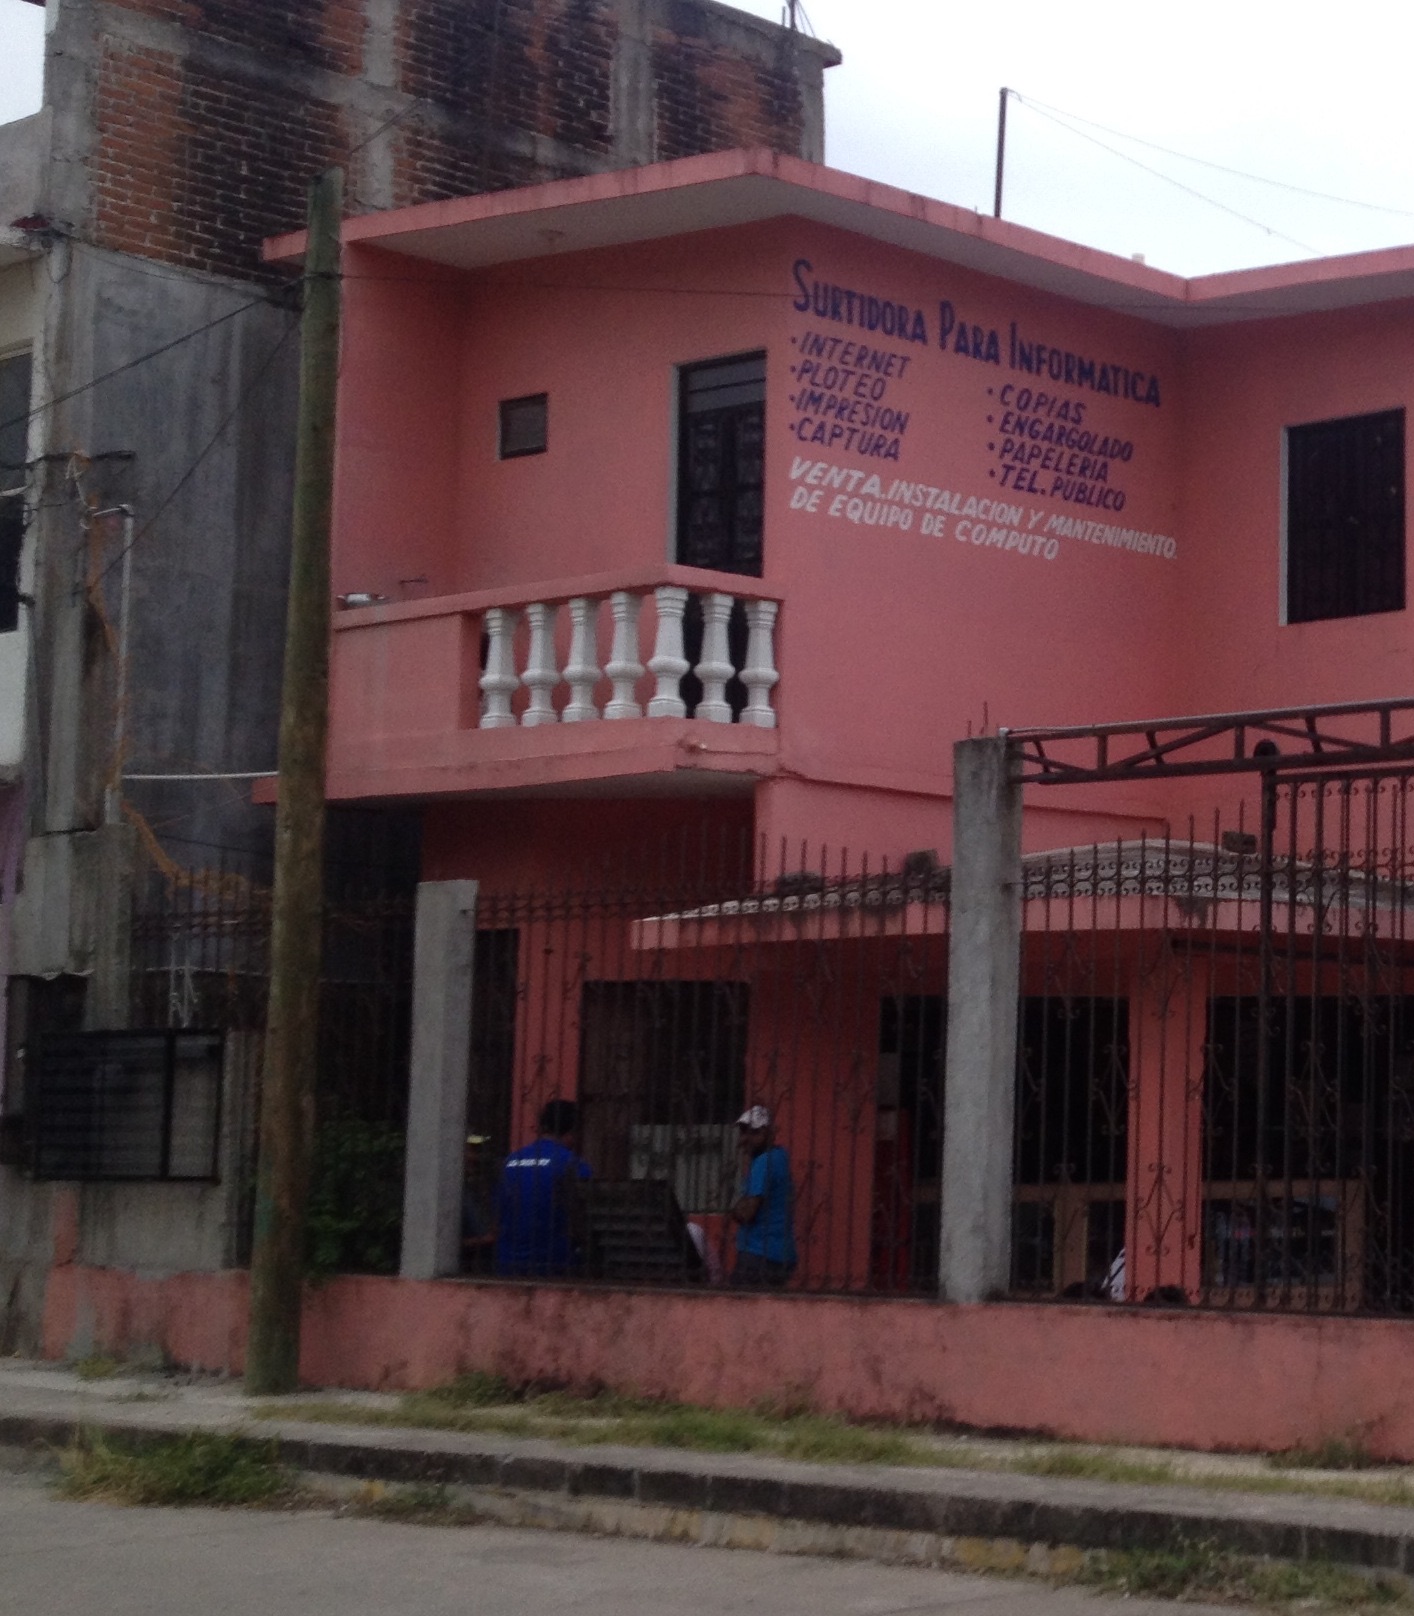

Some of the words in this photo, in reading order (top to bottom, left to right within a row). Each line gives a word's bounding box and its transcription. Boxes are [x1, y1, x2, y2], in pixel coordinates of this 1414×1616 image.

[793, 259, 928, 345] SURTIDORA
[939, 300, 1000, 365] PARA
[1009, 322, 1161, 408] INFORMATICA
[800, 331, 911, 378] INTERNET
[797, 359, 886, 401] PLOTEO
[795, 388, 910, 435] IMPRESION
[1000, 384, 1086, 425] COPIAS
[797, 417, 899, 461] CAPTURA
[1000, 411, 1134, 462] ENGARGOLADO
[1000, 438, 1108, 483] PAPELERIA
[1000, 463, 1046, 495] TEL.
[1050, 476, 1126, 512] PUBLICO
[789, 486, 825, 513] DE
[828, 494, 914, 531] EQUIPO
[920, 512, 946, 537] DE
[955, 519, 1060, 560] COMPUTO
[1029, 508, 1044, 529] Y
